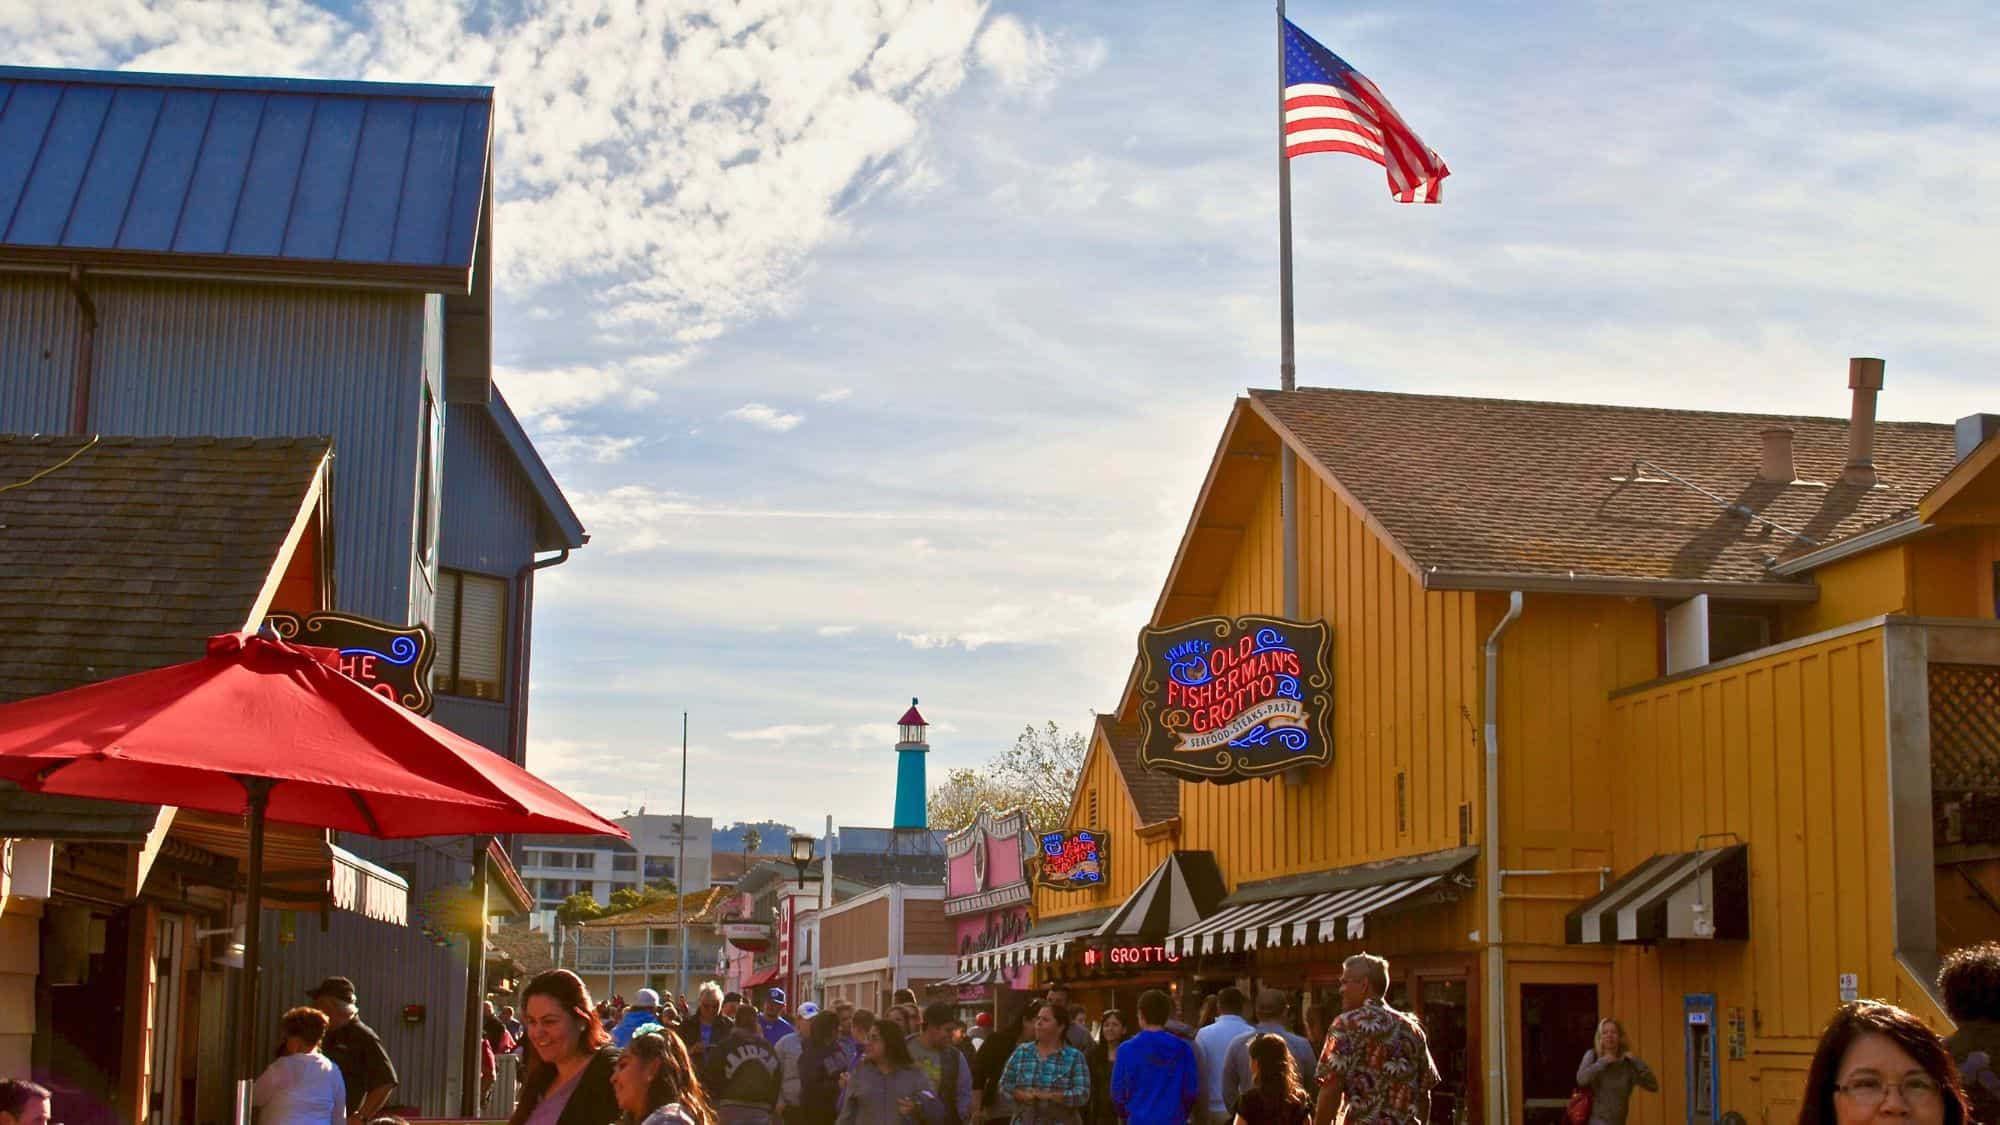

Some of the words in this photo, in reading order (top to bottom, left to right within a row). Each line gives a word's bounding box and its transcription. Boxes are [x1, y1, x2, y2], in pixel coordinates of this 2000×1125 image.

[1168, 650, 1300, 708] FISHERMAN'S
[1210, 636, 1252, 676] OLD
[1193, 675, 1275, 732] GROTTO
